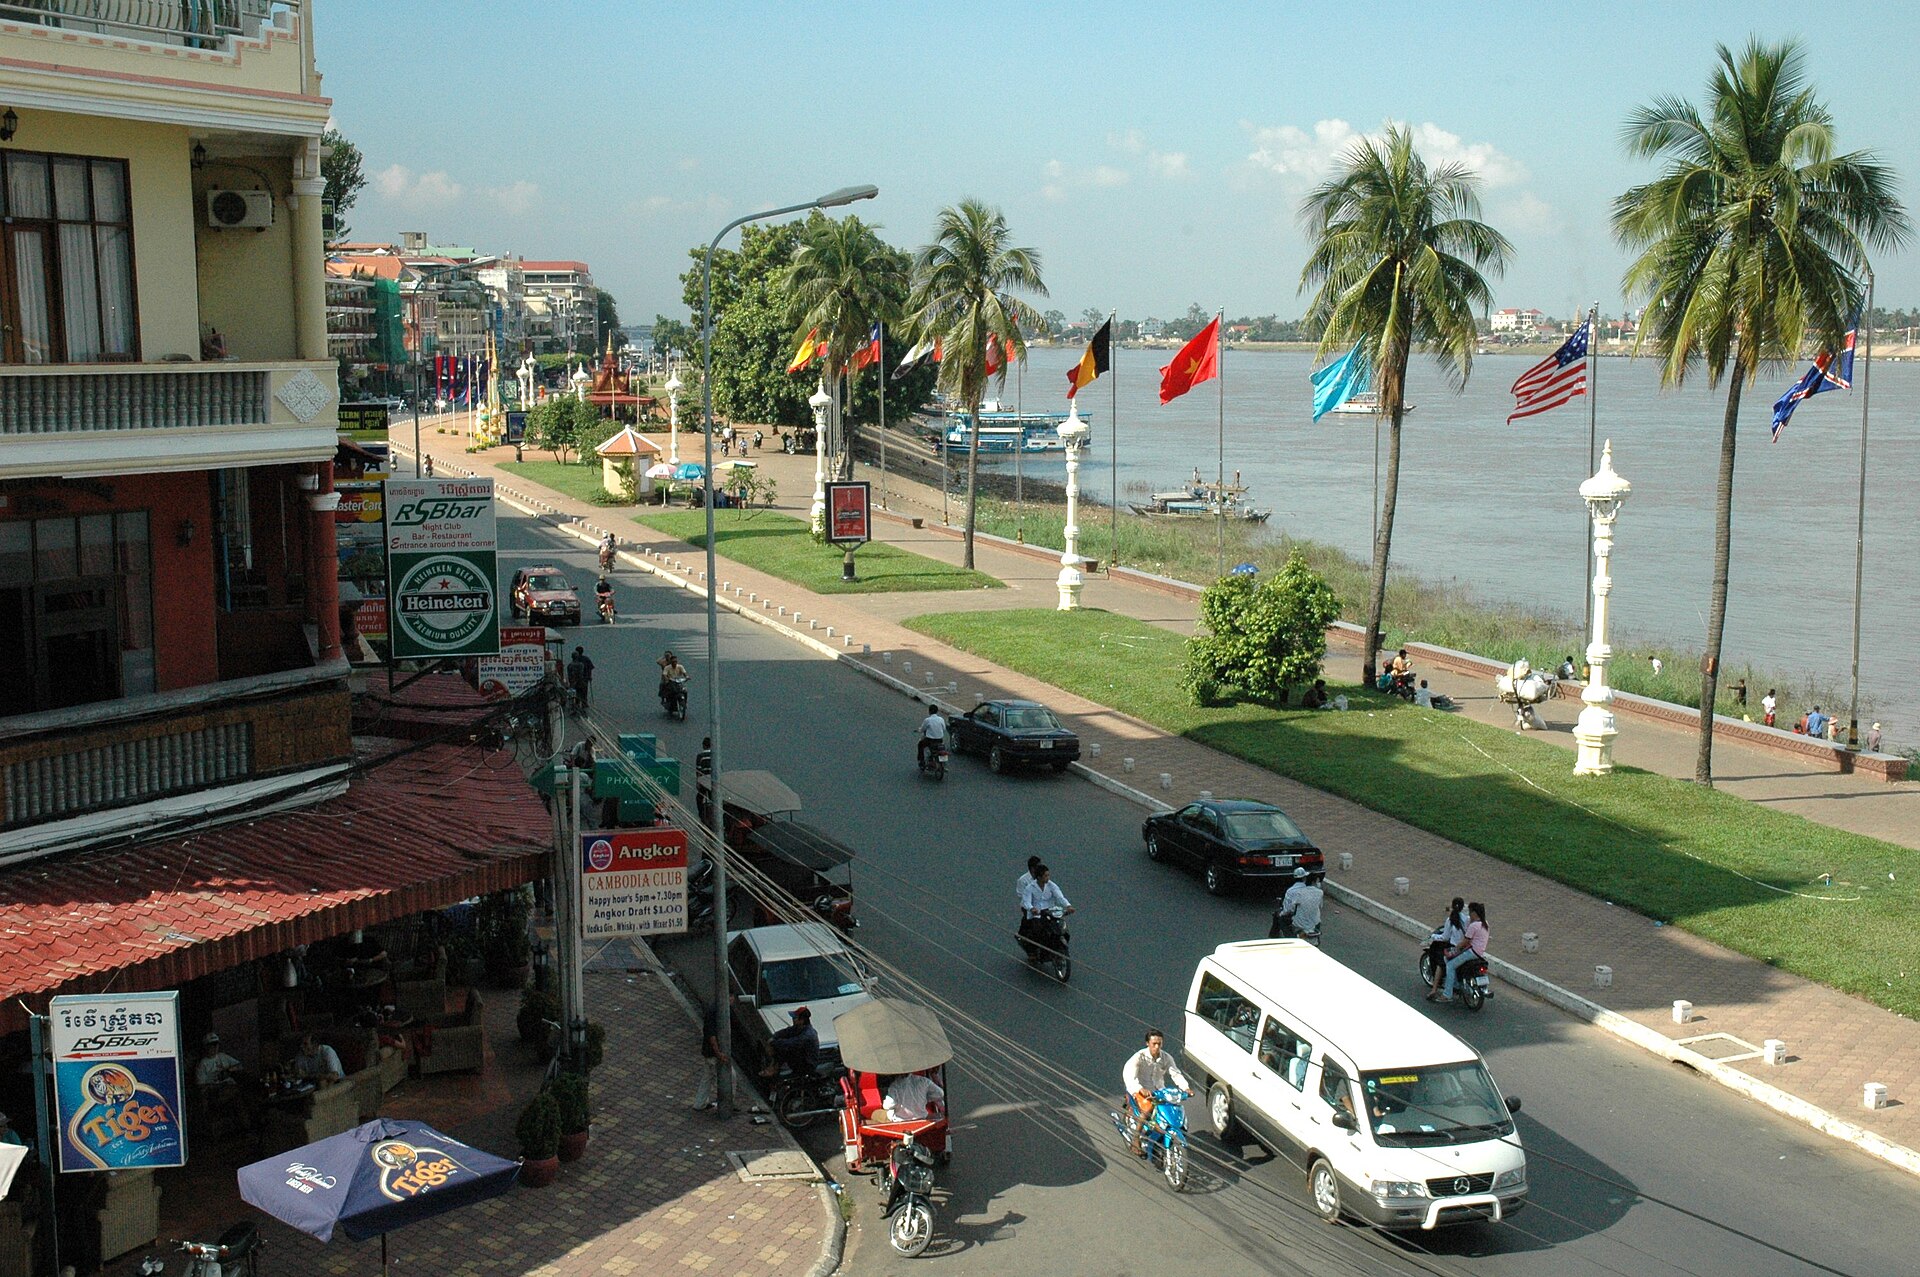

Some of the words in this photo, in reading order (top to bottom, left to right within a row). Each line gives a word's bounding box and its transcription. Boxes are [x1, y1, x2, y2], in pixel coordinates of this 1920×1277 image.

[391, 497, 490, 526] RSBbar
[422, 523, 442, 532] Night
[444, 522, 461, 530] Club
[391, 537, 427, 549] Entrance
[431, 532, 472, 540] Restaurant
[414, 564, 452, 584] HEINEKEN
[455, 567, 474, 582] BEER
[406, 595, 484, 611] Heineken
[357, 616, 378, 624] unny
[357, 623, 383, 631] ternet
[413, 620, 447, 640] PREMIUM
[449, 618, 478, 639] QUALITY
[606, 776, 670, 785] PHARCY
[619, 843, 681, 861] Angkor
[588, 874, 650, 891] CAMBODIA
[653, 871, 682, 887] CLUB
[589, 895, 611, 906] Happy
[612, 894, 633, 904] hour's
[635, 893, 650, 904] 5pm
[657, 891, 682, 901] 7.30pm
[594, 909, 626, 920] Angkor
[628, 906, 651, 916] Draft
[653, 904, 682, 914] $1.00
[587, 924, 603, 933] Vodka
[71, 1032, 159, 1051] RSBbar
[83, 1100, 170, 1147] Tiger
[392, 1158, 458, 1195] Tiger
